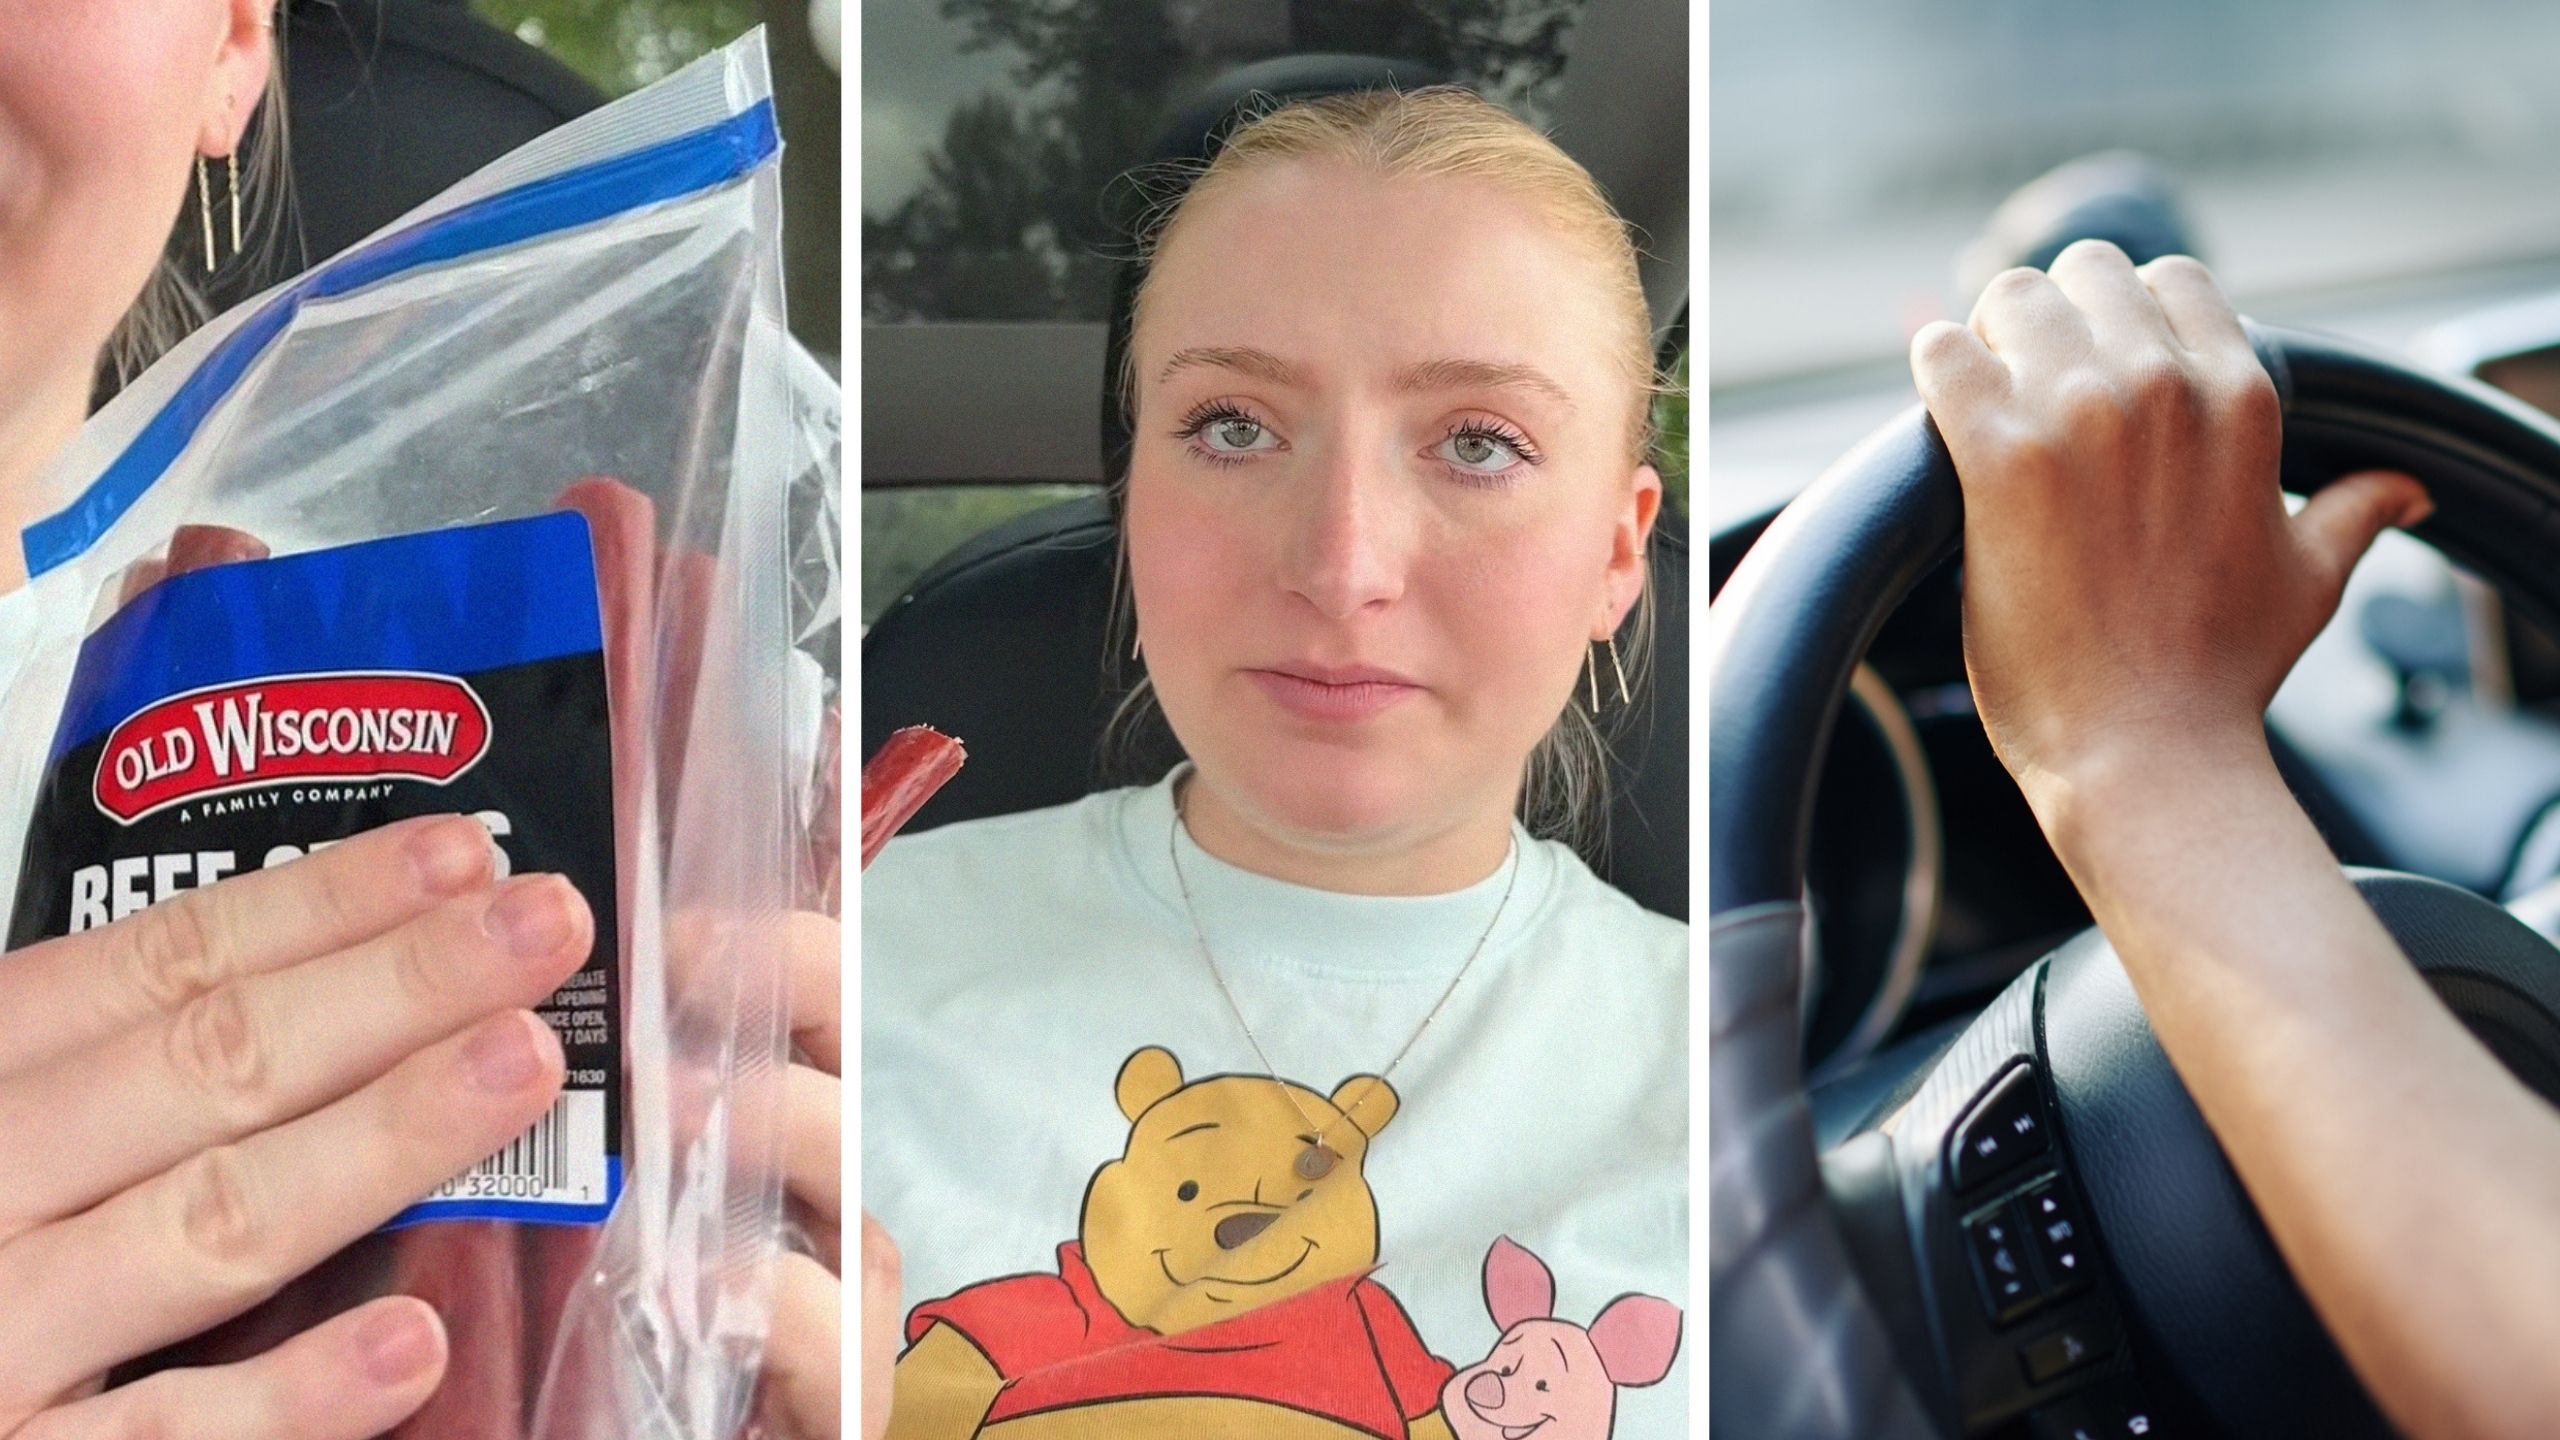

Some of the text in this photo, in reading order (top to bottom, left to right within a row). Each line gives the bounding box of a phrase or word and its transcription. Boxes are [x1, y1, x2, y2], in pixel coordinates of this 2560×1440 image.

[114, 692, 459, 791] OLD WISCONSIN
[180, 784, 395, 823] A FAMILY COMPANY
[556, 989, 607, 1006] OPENING
[564, 1029, 574, 1045] 7
[575, 1028, 608, 1045] DAYS
[468, 1175, 544, 1197] 32000
[580, 1185, 590, 1200] 1
